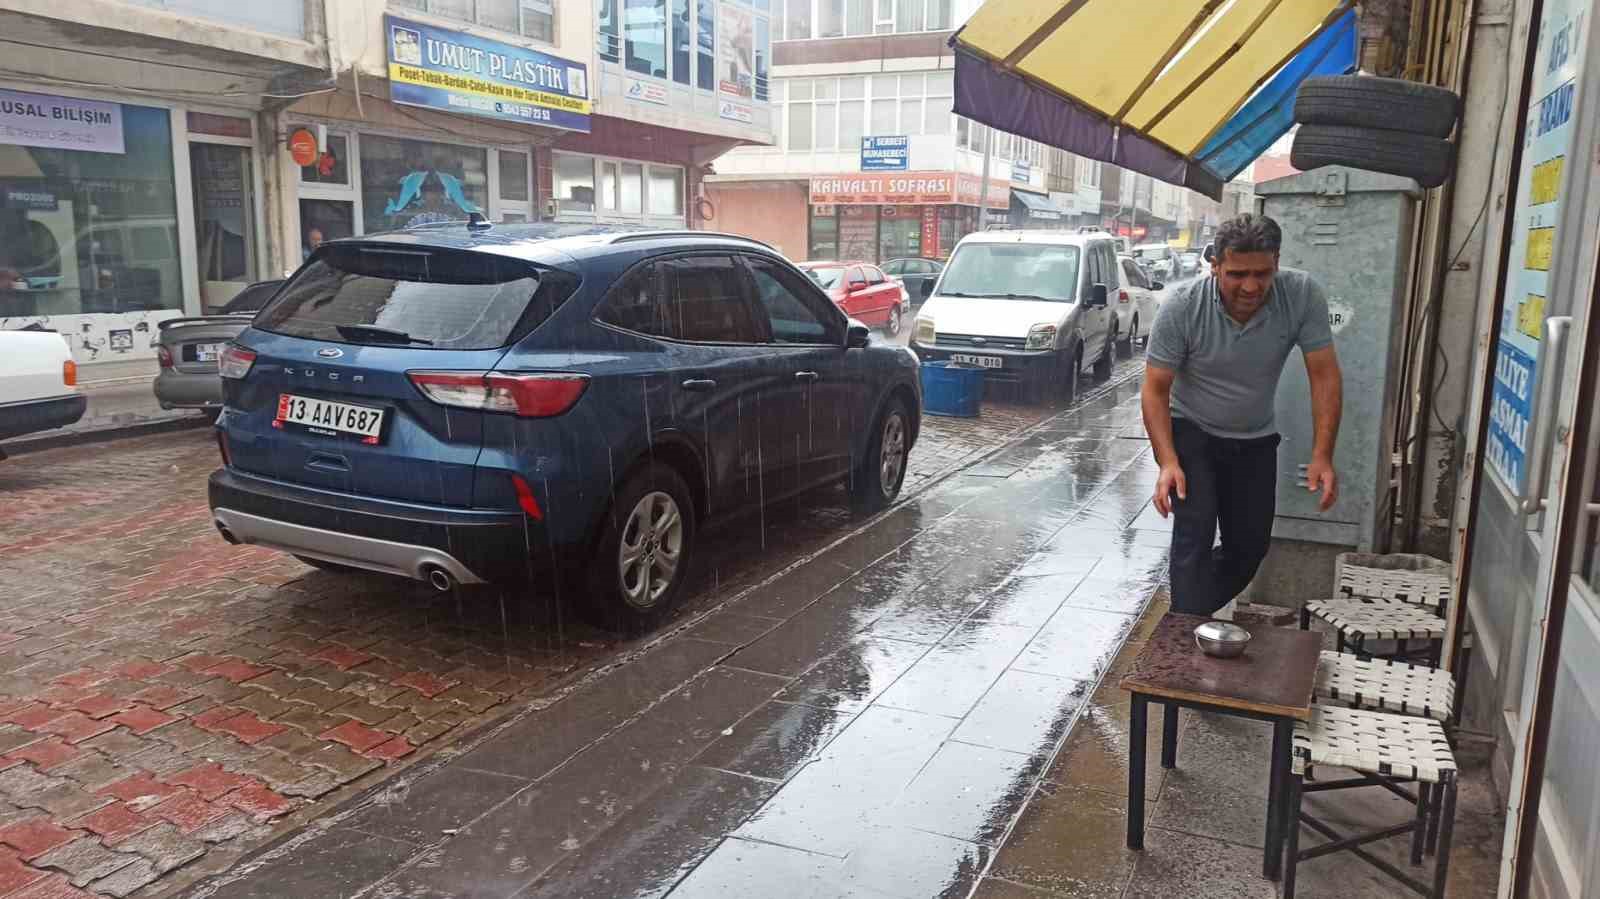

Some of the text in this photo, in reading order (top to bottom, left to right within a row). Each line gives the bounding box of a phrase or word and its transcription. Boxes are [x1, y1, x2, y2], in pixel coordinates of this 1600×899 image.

[426, 39, 564, 90] UMUT PLASTİK
[0, 101, 47, 118] USAL
[811, 179, 883, 194] KAHVALTI
[888, 178, 951, 194] SOFRASI
[289, 399, 306, 420] 13
